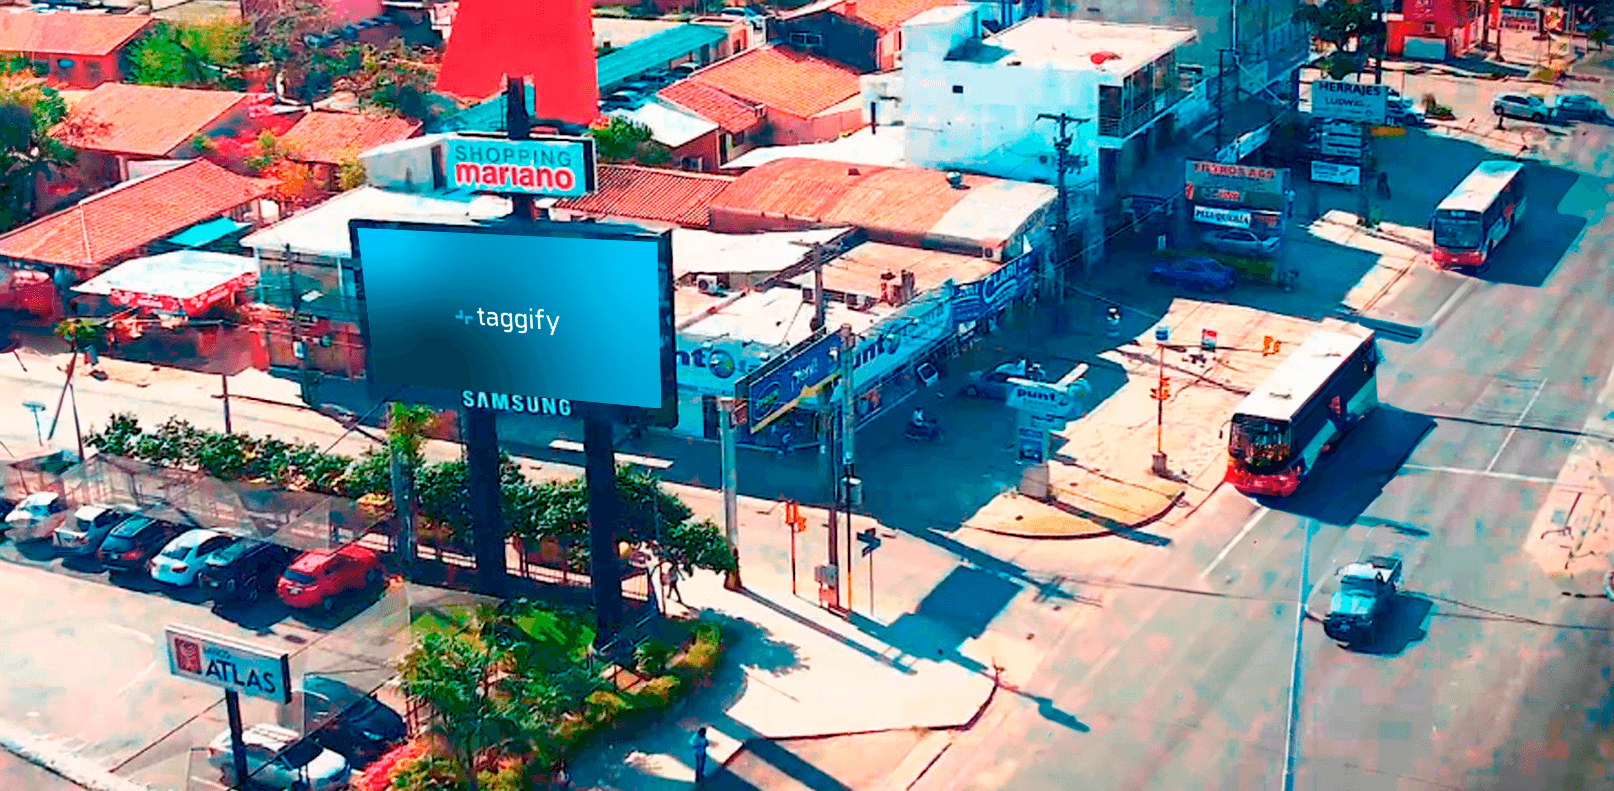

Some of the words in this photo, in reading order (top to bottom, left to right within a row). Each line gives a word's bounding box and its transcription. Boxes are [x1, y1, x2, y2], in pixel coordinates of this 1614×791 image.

[1319, 82, 1381, 96] HERRAJES
[455, 145, 571, 167] SHOPPING
[455, 162, 574, 190] mariano
[477, 308, 560, 335] taggify
[675, 349, 706, 368] nt
[462, 390, 572, 416] SAMSUNG
[206, 659, 275, 693] ATLAS
